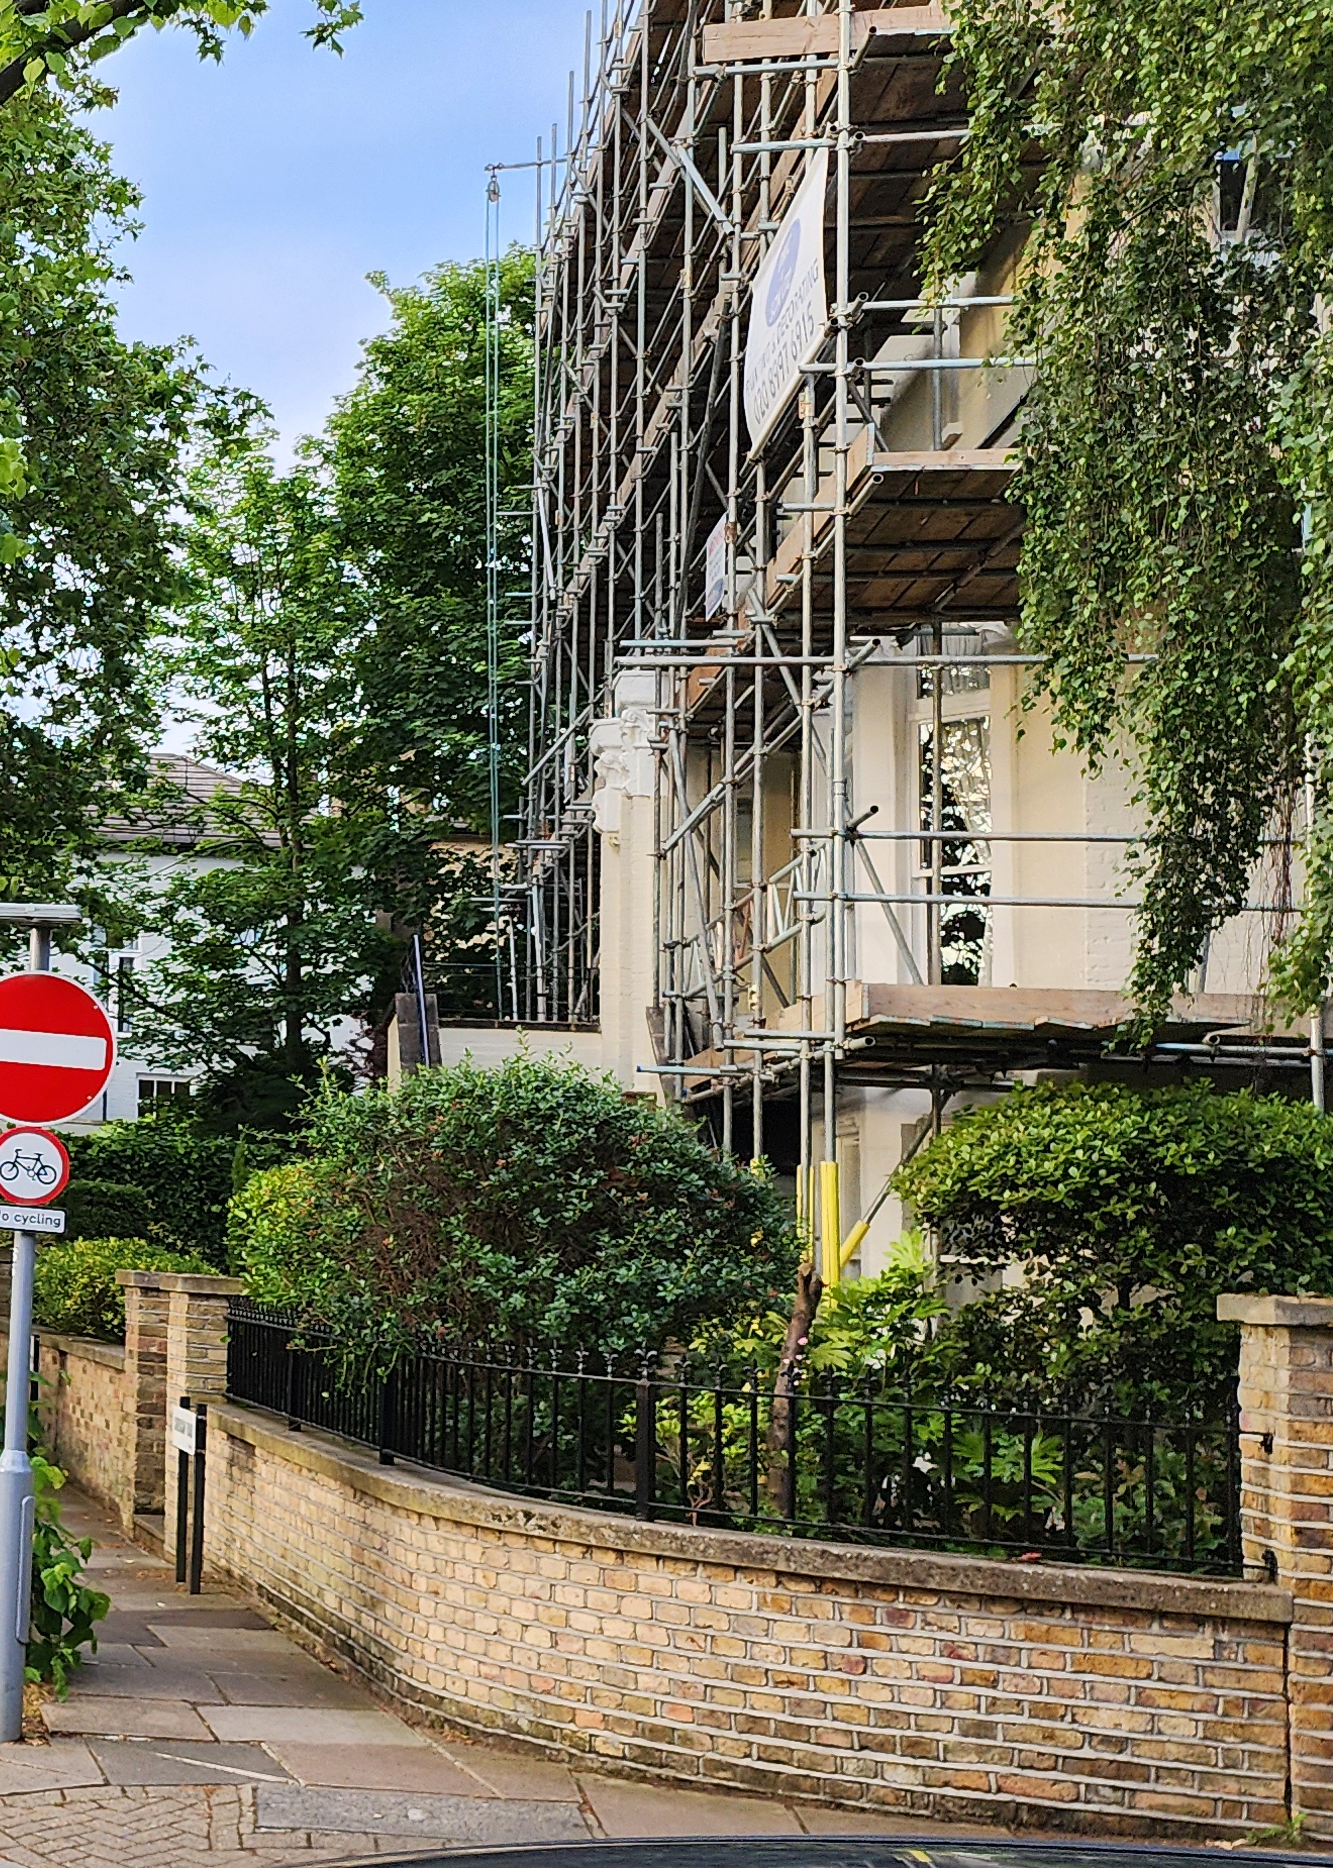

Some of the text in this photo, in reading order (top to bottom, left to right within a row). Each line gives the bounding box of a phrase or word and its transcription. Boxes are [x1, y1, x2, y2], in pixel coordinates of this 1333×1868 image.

[753, 380, 769, 424] 020
[768, 341, 789, 399] 8997
[791, 300, 814, 361] 6915
[14, 1213, 61, 1228] cycling
